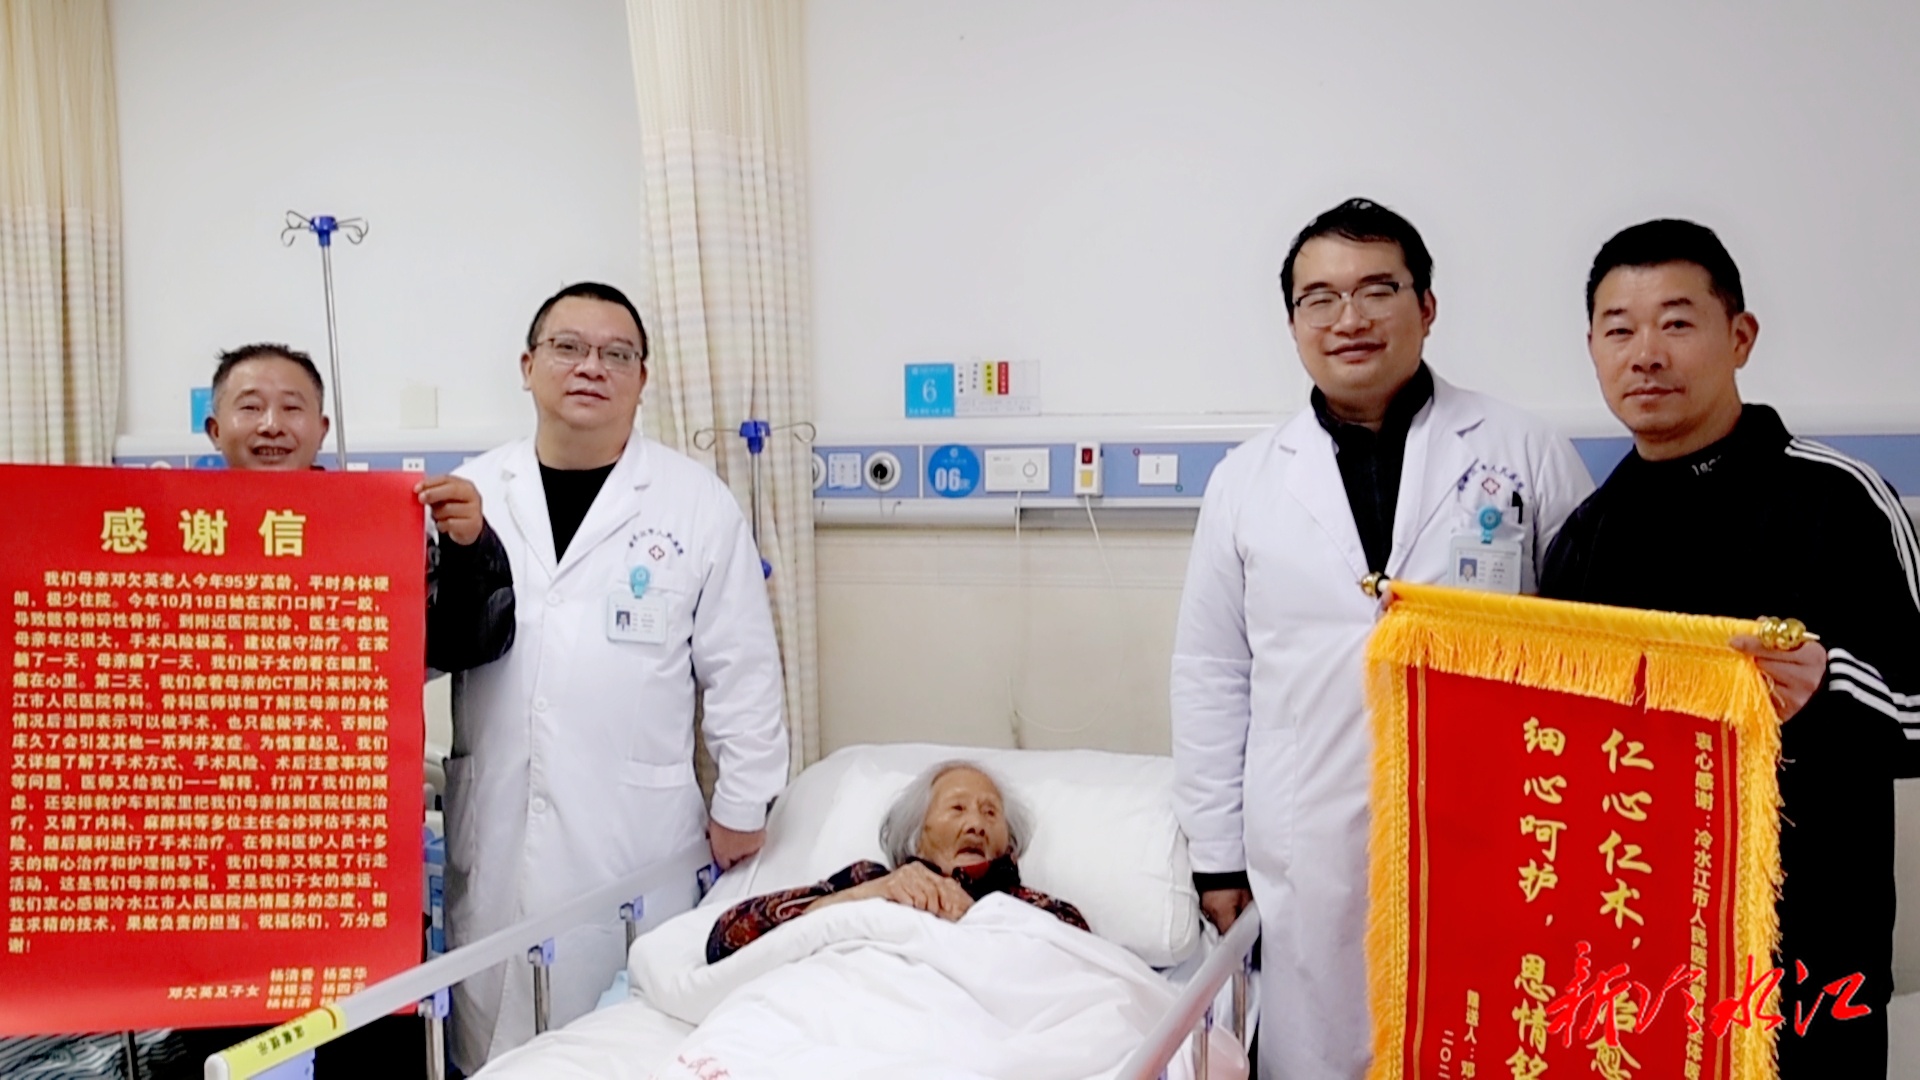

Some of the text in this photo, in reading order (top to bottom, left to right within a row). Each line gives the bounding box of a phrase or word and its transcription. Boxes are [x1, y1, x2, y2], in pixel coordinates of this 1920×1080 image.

[922, 379, 938, 403] 6
[100, 507, 307, 557] 感谢信
